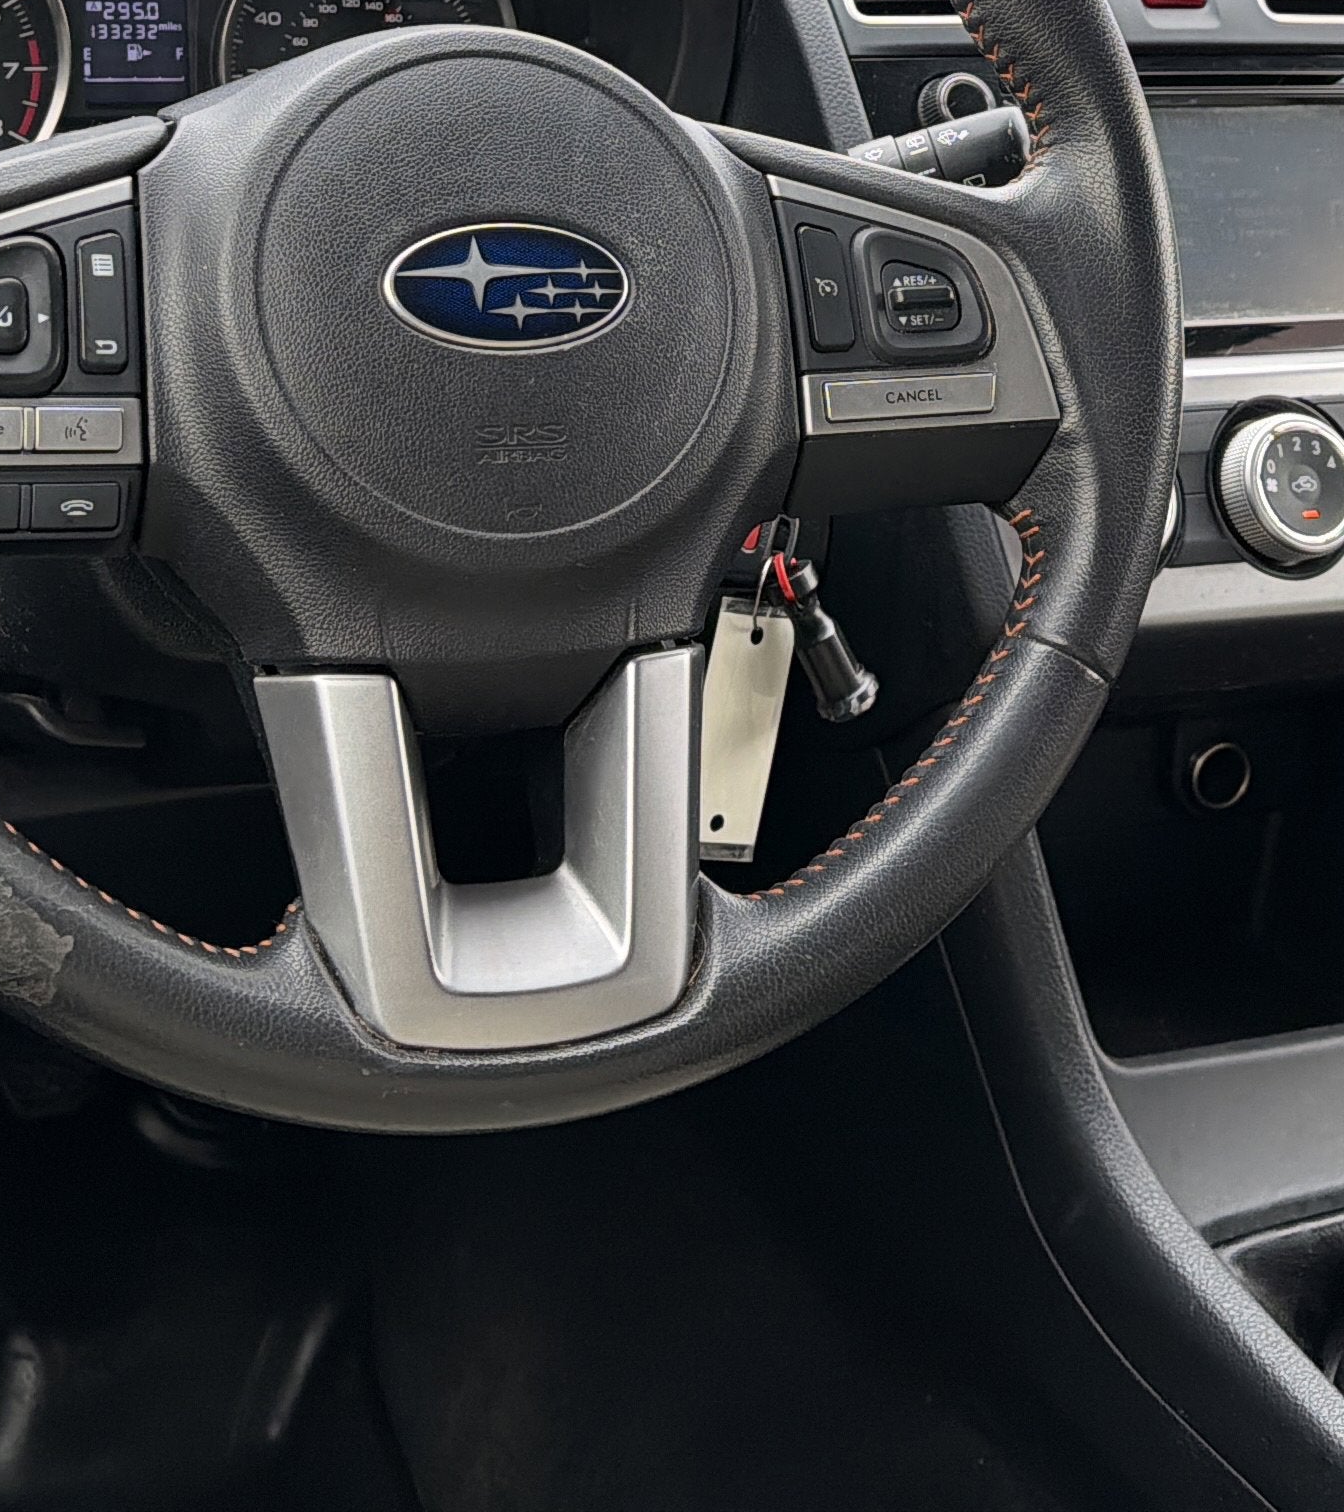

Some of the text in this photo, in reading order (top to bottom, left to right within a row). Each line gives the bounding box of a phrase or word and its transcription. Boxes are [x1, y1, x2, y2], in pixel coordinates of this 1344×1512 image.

[318, 3, 338, 15] 100
[364, 0, 384, 12] 140
[254, 11, 282, 26] 40
[302, 17, 319, 29] 80
[384, 12, 404, 24] 160
[158, 22, 183, 32] miles
[292, 36, 309, 48] 60
[83, 46, 184, 62] E F
[2, 61, 20, 79] 7
[885, 389, 943, 404] CANCEL
[475, 424, 568, 446] SRS
[1276, 443, 1284, 458] 1
[1291, 436, 1302, 452] 2
[1310, 440, 1321, 456] 3
[1266, 458, 1277, 474] 0
[1326, 455, 1337, 469] 4
